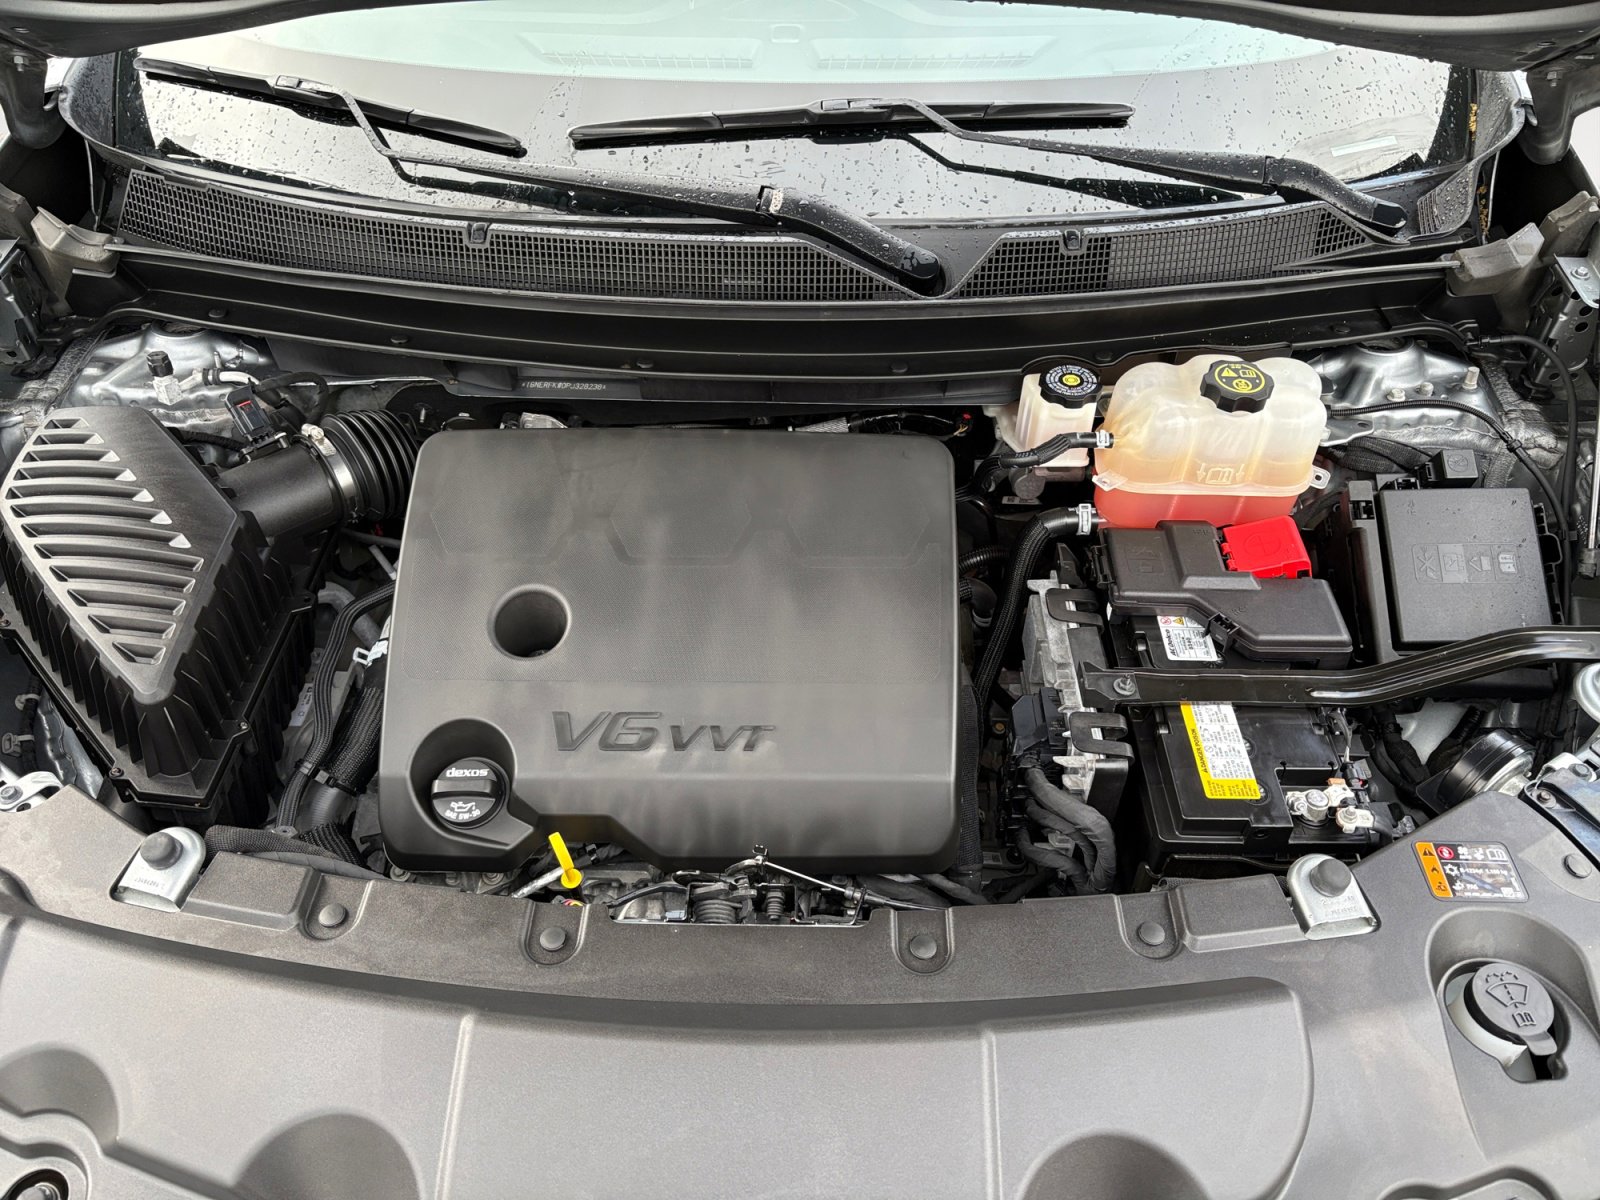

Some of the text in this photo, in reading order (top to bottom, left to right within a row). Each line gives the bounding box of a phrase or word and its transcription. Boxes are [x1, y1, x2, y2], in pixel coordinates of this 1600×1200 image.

[552, 711, 776, 752] V6 VVT
[446, 767, 490, 778] dexos
[445, 809, 458, 820] SAE
